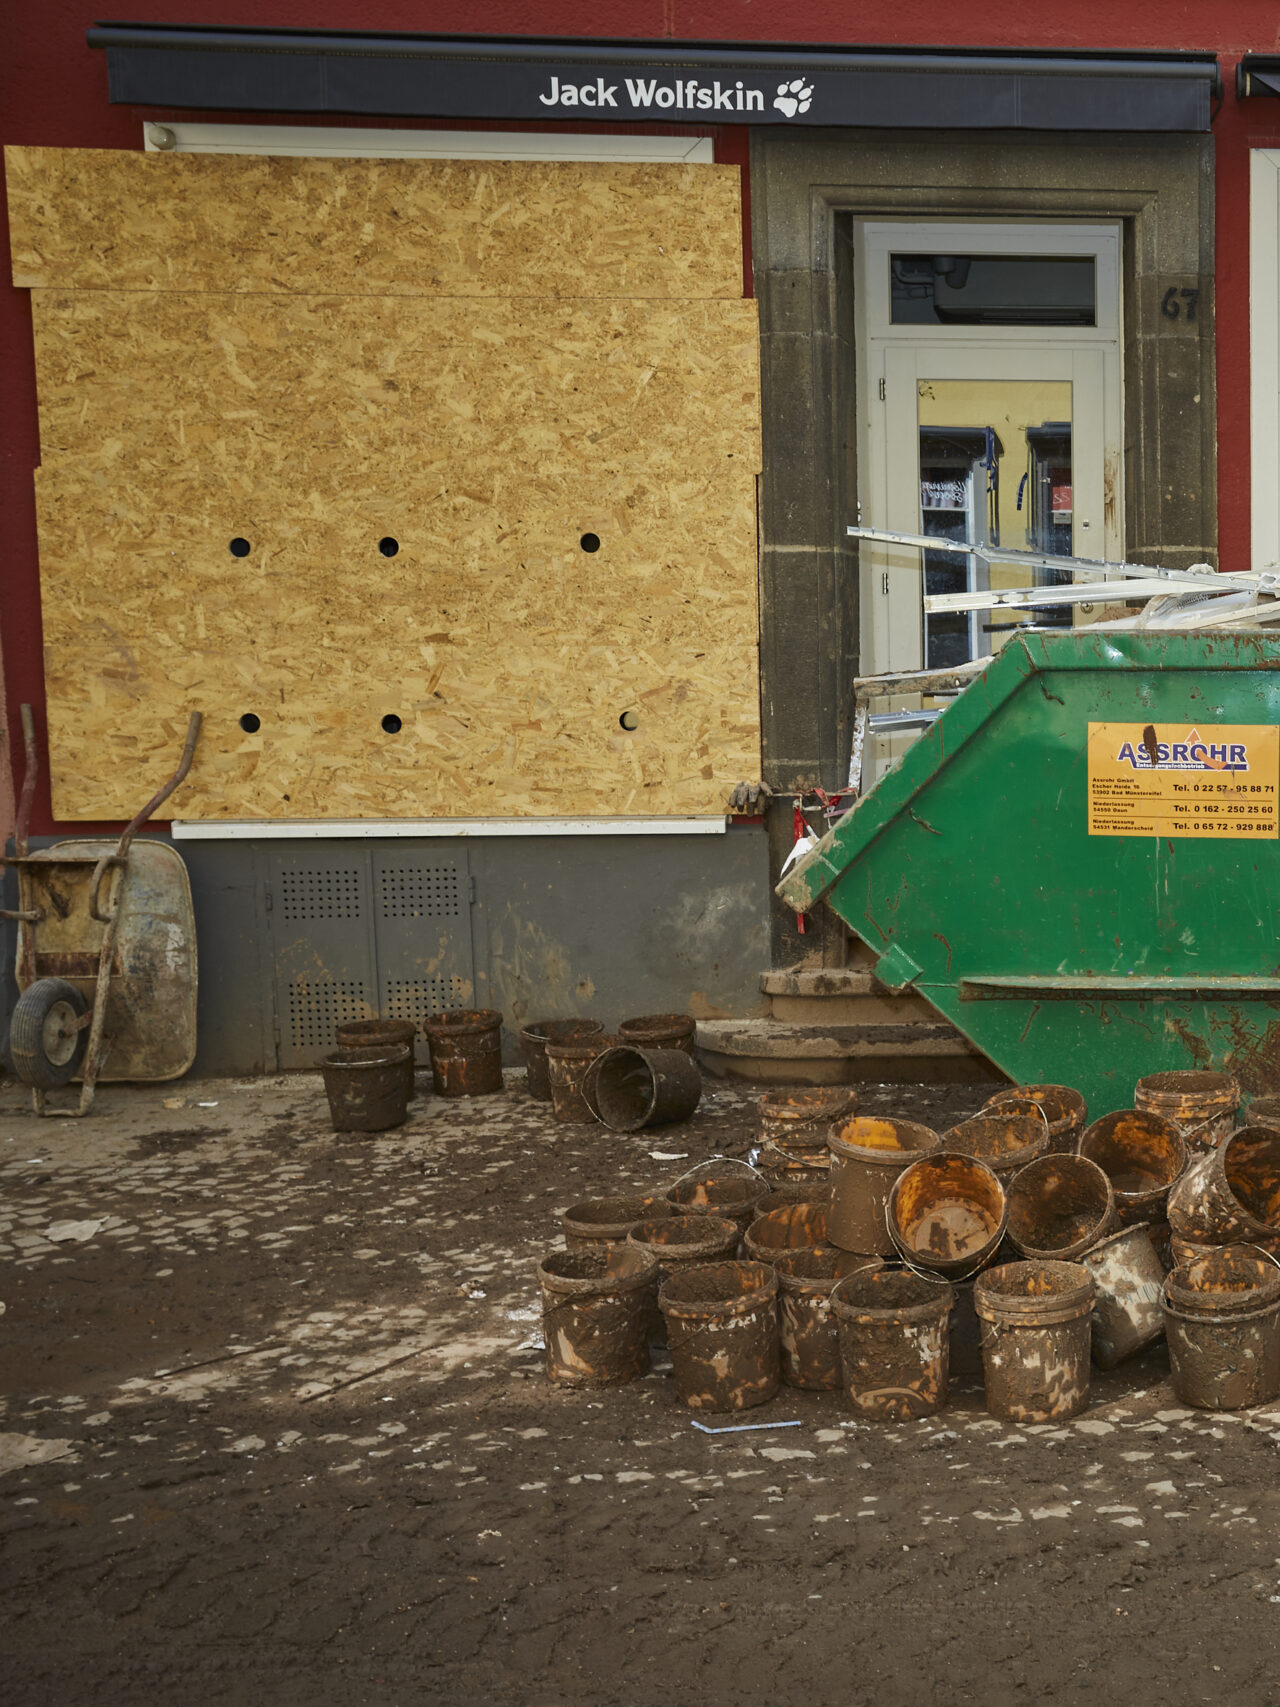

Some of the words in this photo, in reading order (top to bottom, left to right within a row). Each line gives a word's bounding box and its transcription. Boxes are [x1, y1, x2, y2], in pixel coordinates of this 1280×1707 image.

[539, 77, 618, 107] Jack
[624, 79, 764, 111] Wolfskin
[1161, 287, 1200, 321] 67
[1117, 742, 1247, 763] ASSROHR
[1173, 784, 1190, 792] Tel.
[1193, 784, 1200, 792] 0
[1202, 784, 1214, 792] 22
[1235, 785, 1248, 793] 95
[1250, 785, 1262, 793] 88
[1264, 785, 1274, 793] 71
[1227, 805, 1245, 813] 250
[1173, 822, 1190, 830] Tel.
[1236, 823, 1253, 831] 929
[1256, 823, 1273, 831] 888
